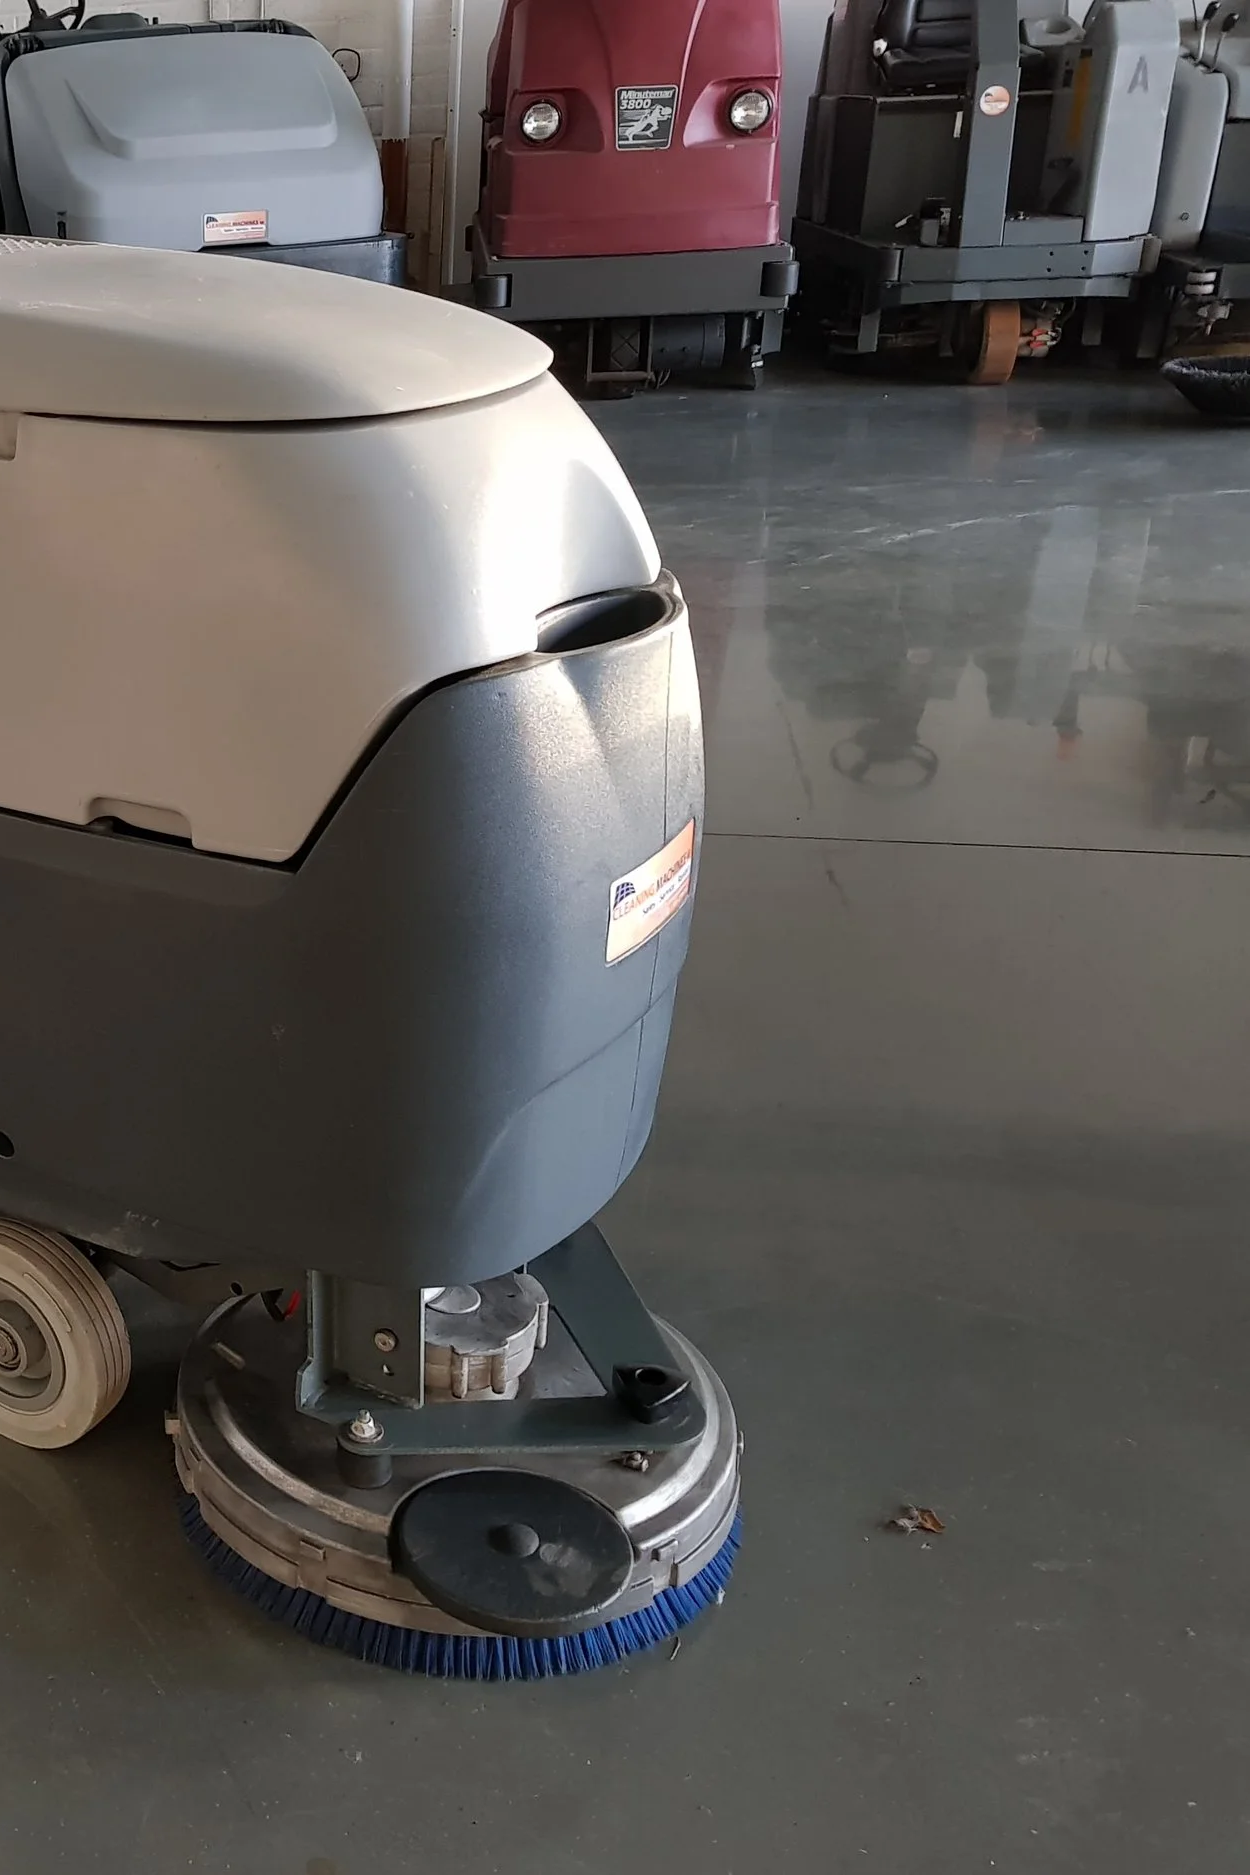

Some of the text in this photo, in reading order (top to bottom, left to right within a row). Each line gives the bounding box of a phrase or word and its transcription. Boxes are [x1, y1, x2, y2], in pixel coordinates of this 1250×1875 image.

[1127, 55, 1149, 94] A
[620, 89, 675, 100] Minuteman
[612, 882, 655, 921] CLEANING
